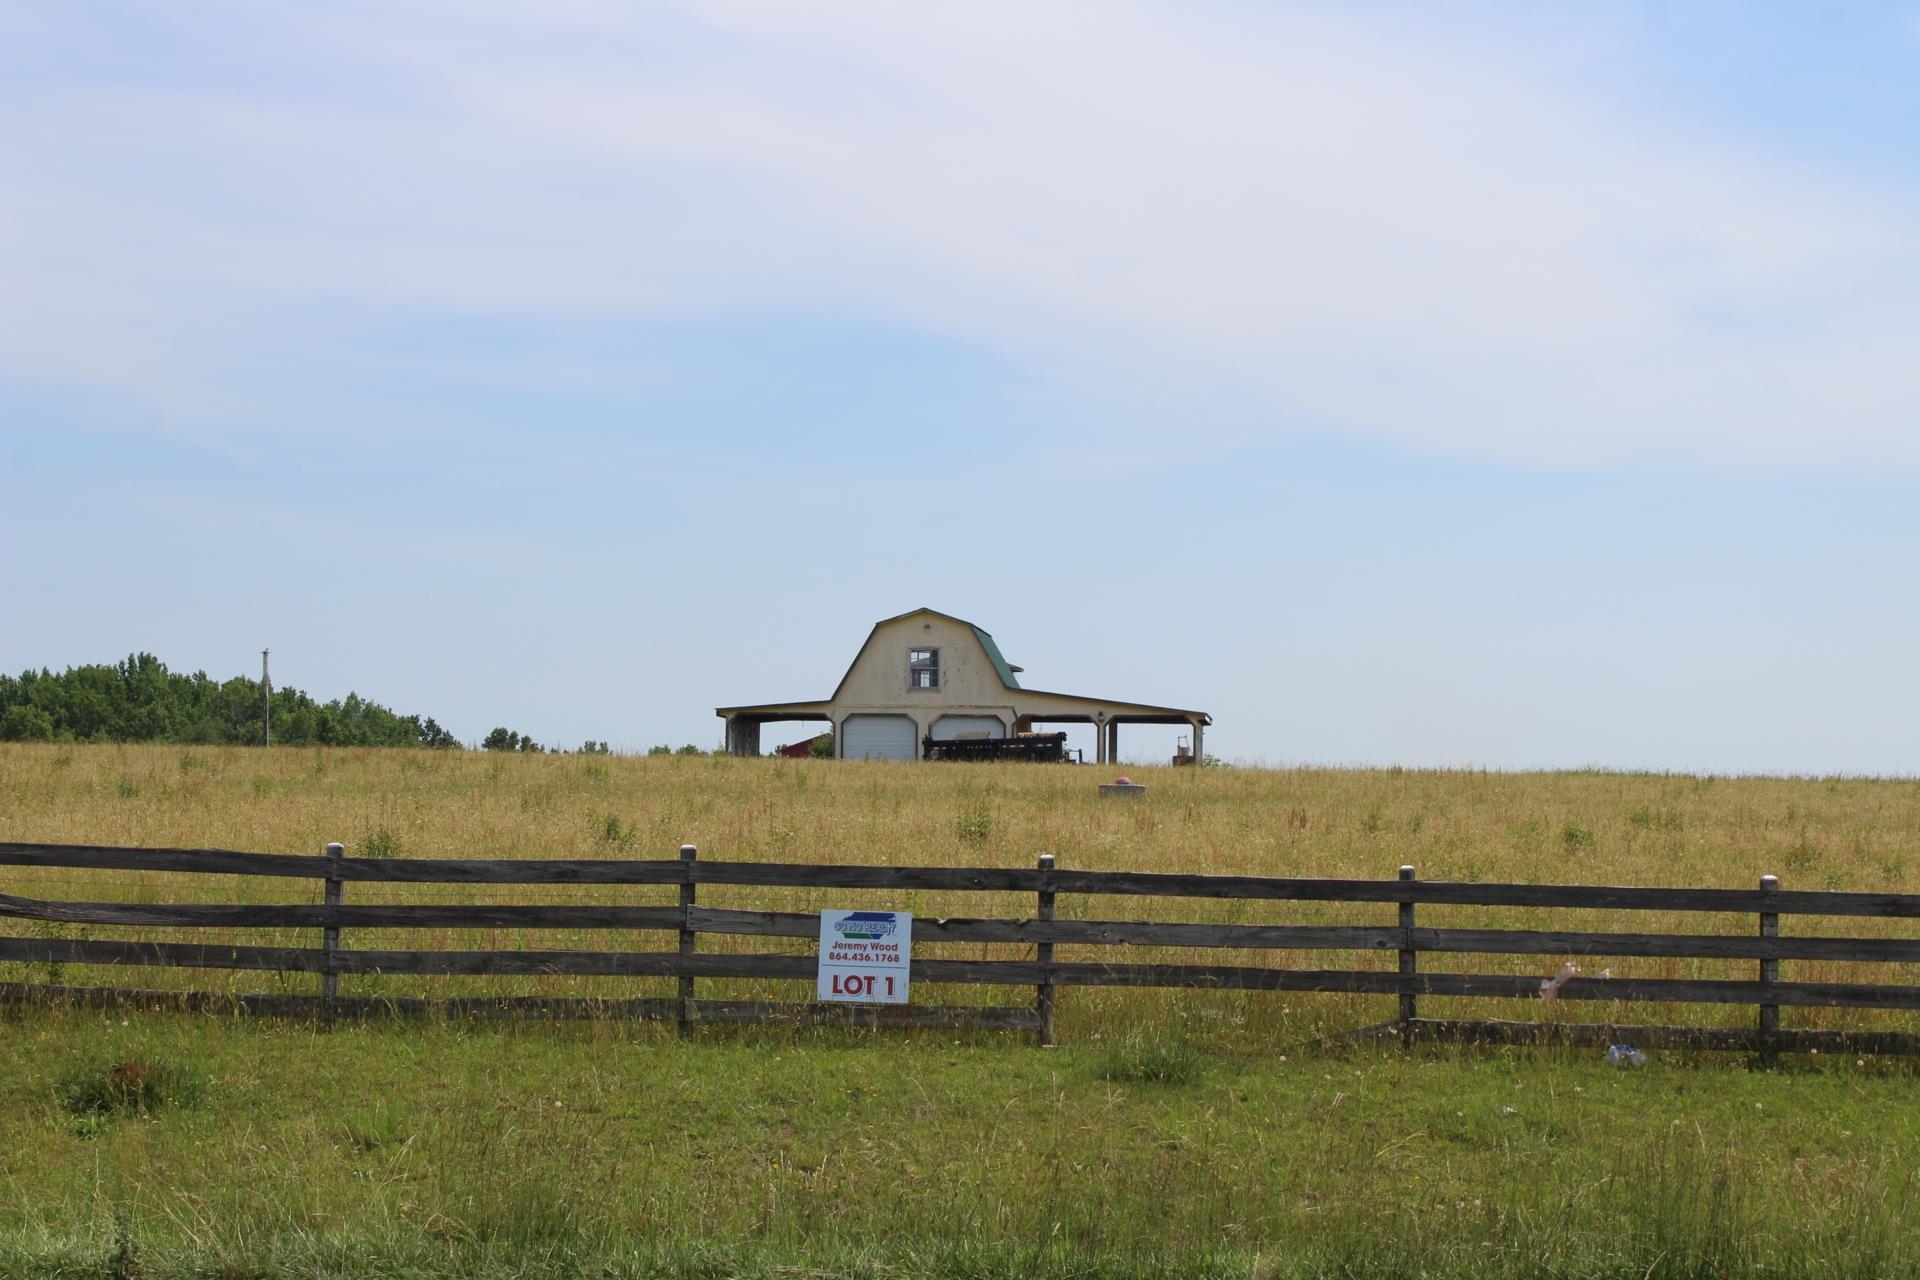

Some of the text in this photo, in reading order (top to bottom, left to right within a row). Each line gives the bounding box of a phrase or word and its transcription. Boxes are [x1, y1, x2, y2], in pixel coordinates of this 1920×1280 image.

[832, 941, 898, 952] Jeremy Wood
[829, 952, 900, 962] 864.436.1768
[832, 975, 894, 996] LOT 1
